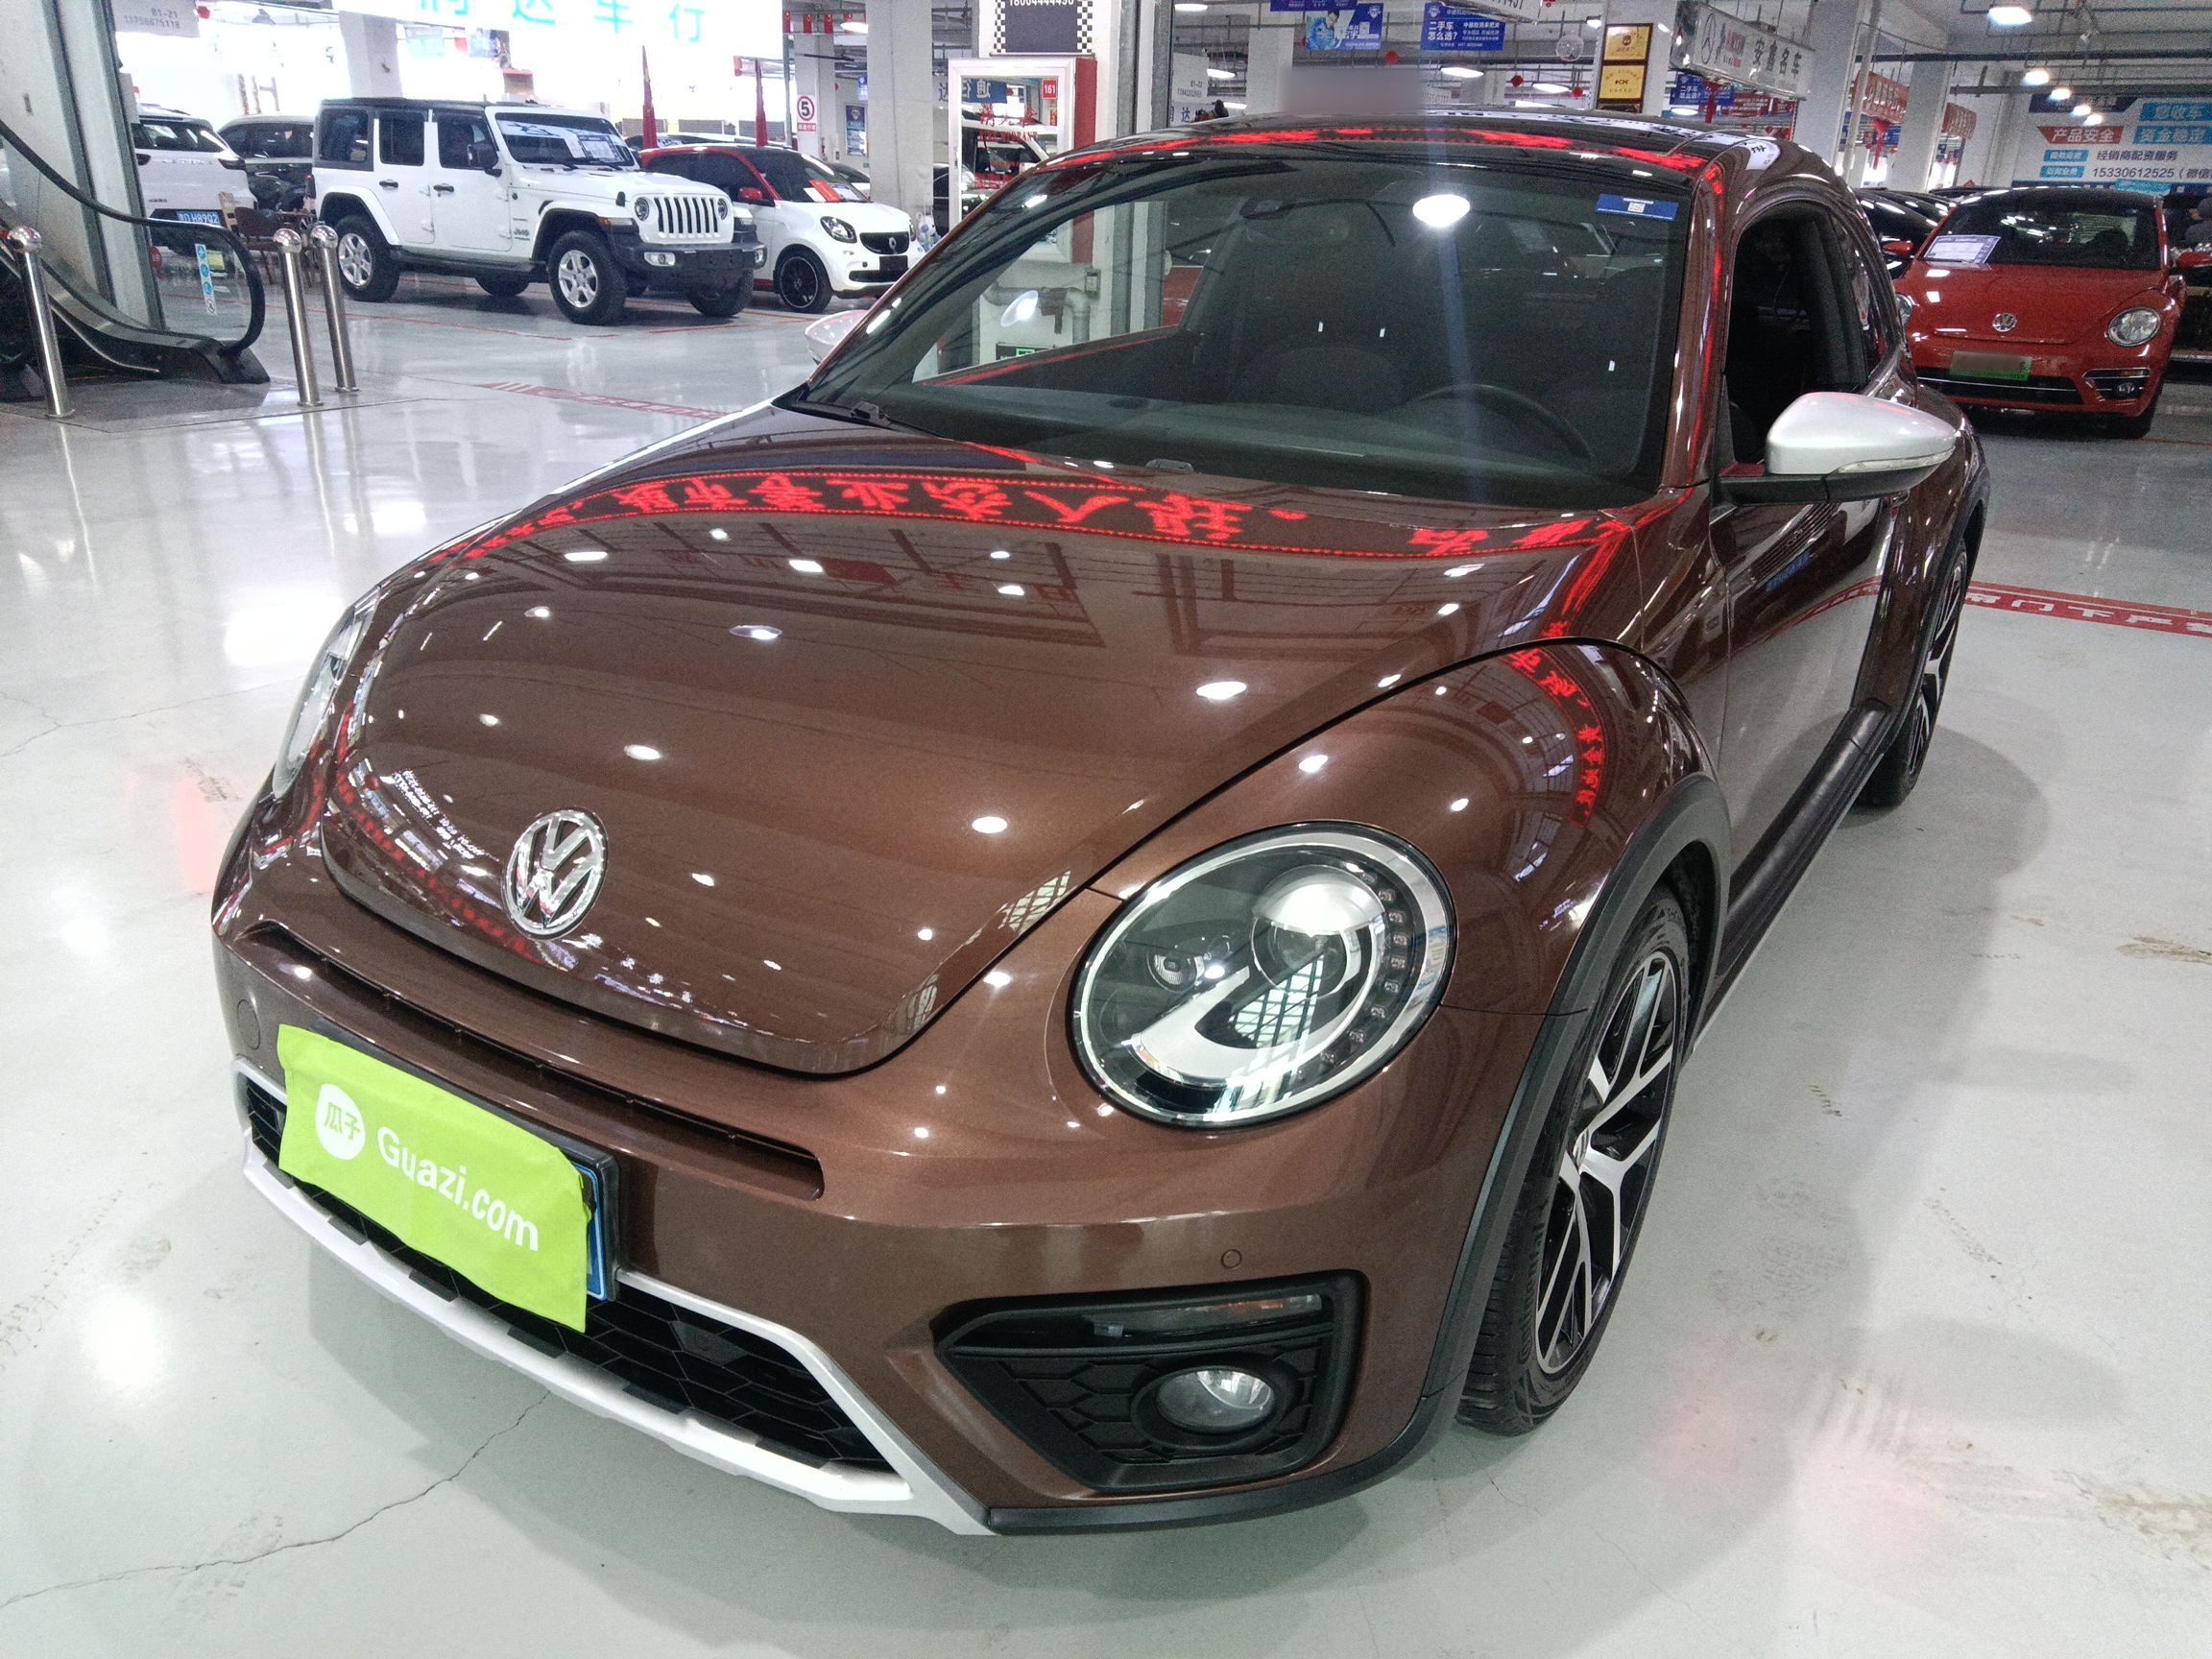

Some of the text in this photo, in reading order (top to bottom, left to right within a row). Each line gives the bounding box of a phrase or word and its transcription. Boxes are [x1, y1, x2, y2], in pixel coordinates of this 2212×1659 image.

[801, 101, 810, 116] 5
[2052, 129, 2114, 142] 产品安全
[2092, 167, 2175, 179] 15330612525
[325, 1102, 361, 1141] 瓜子
[377, 1126, 539, 1252] Guazi.com
